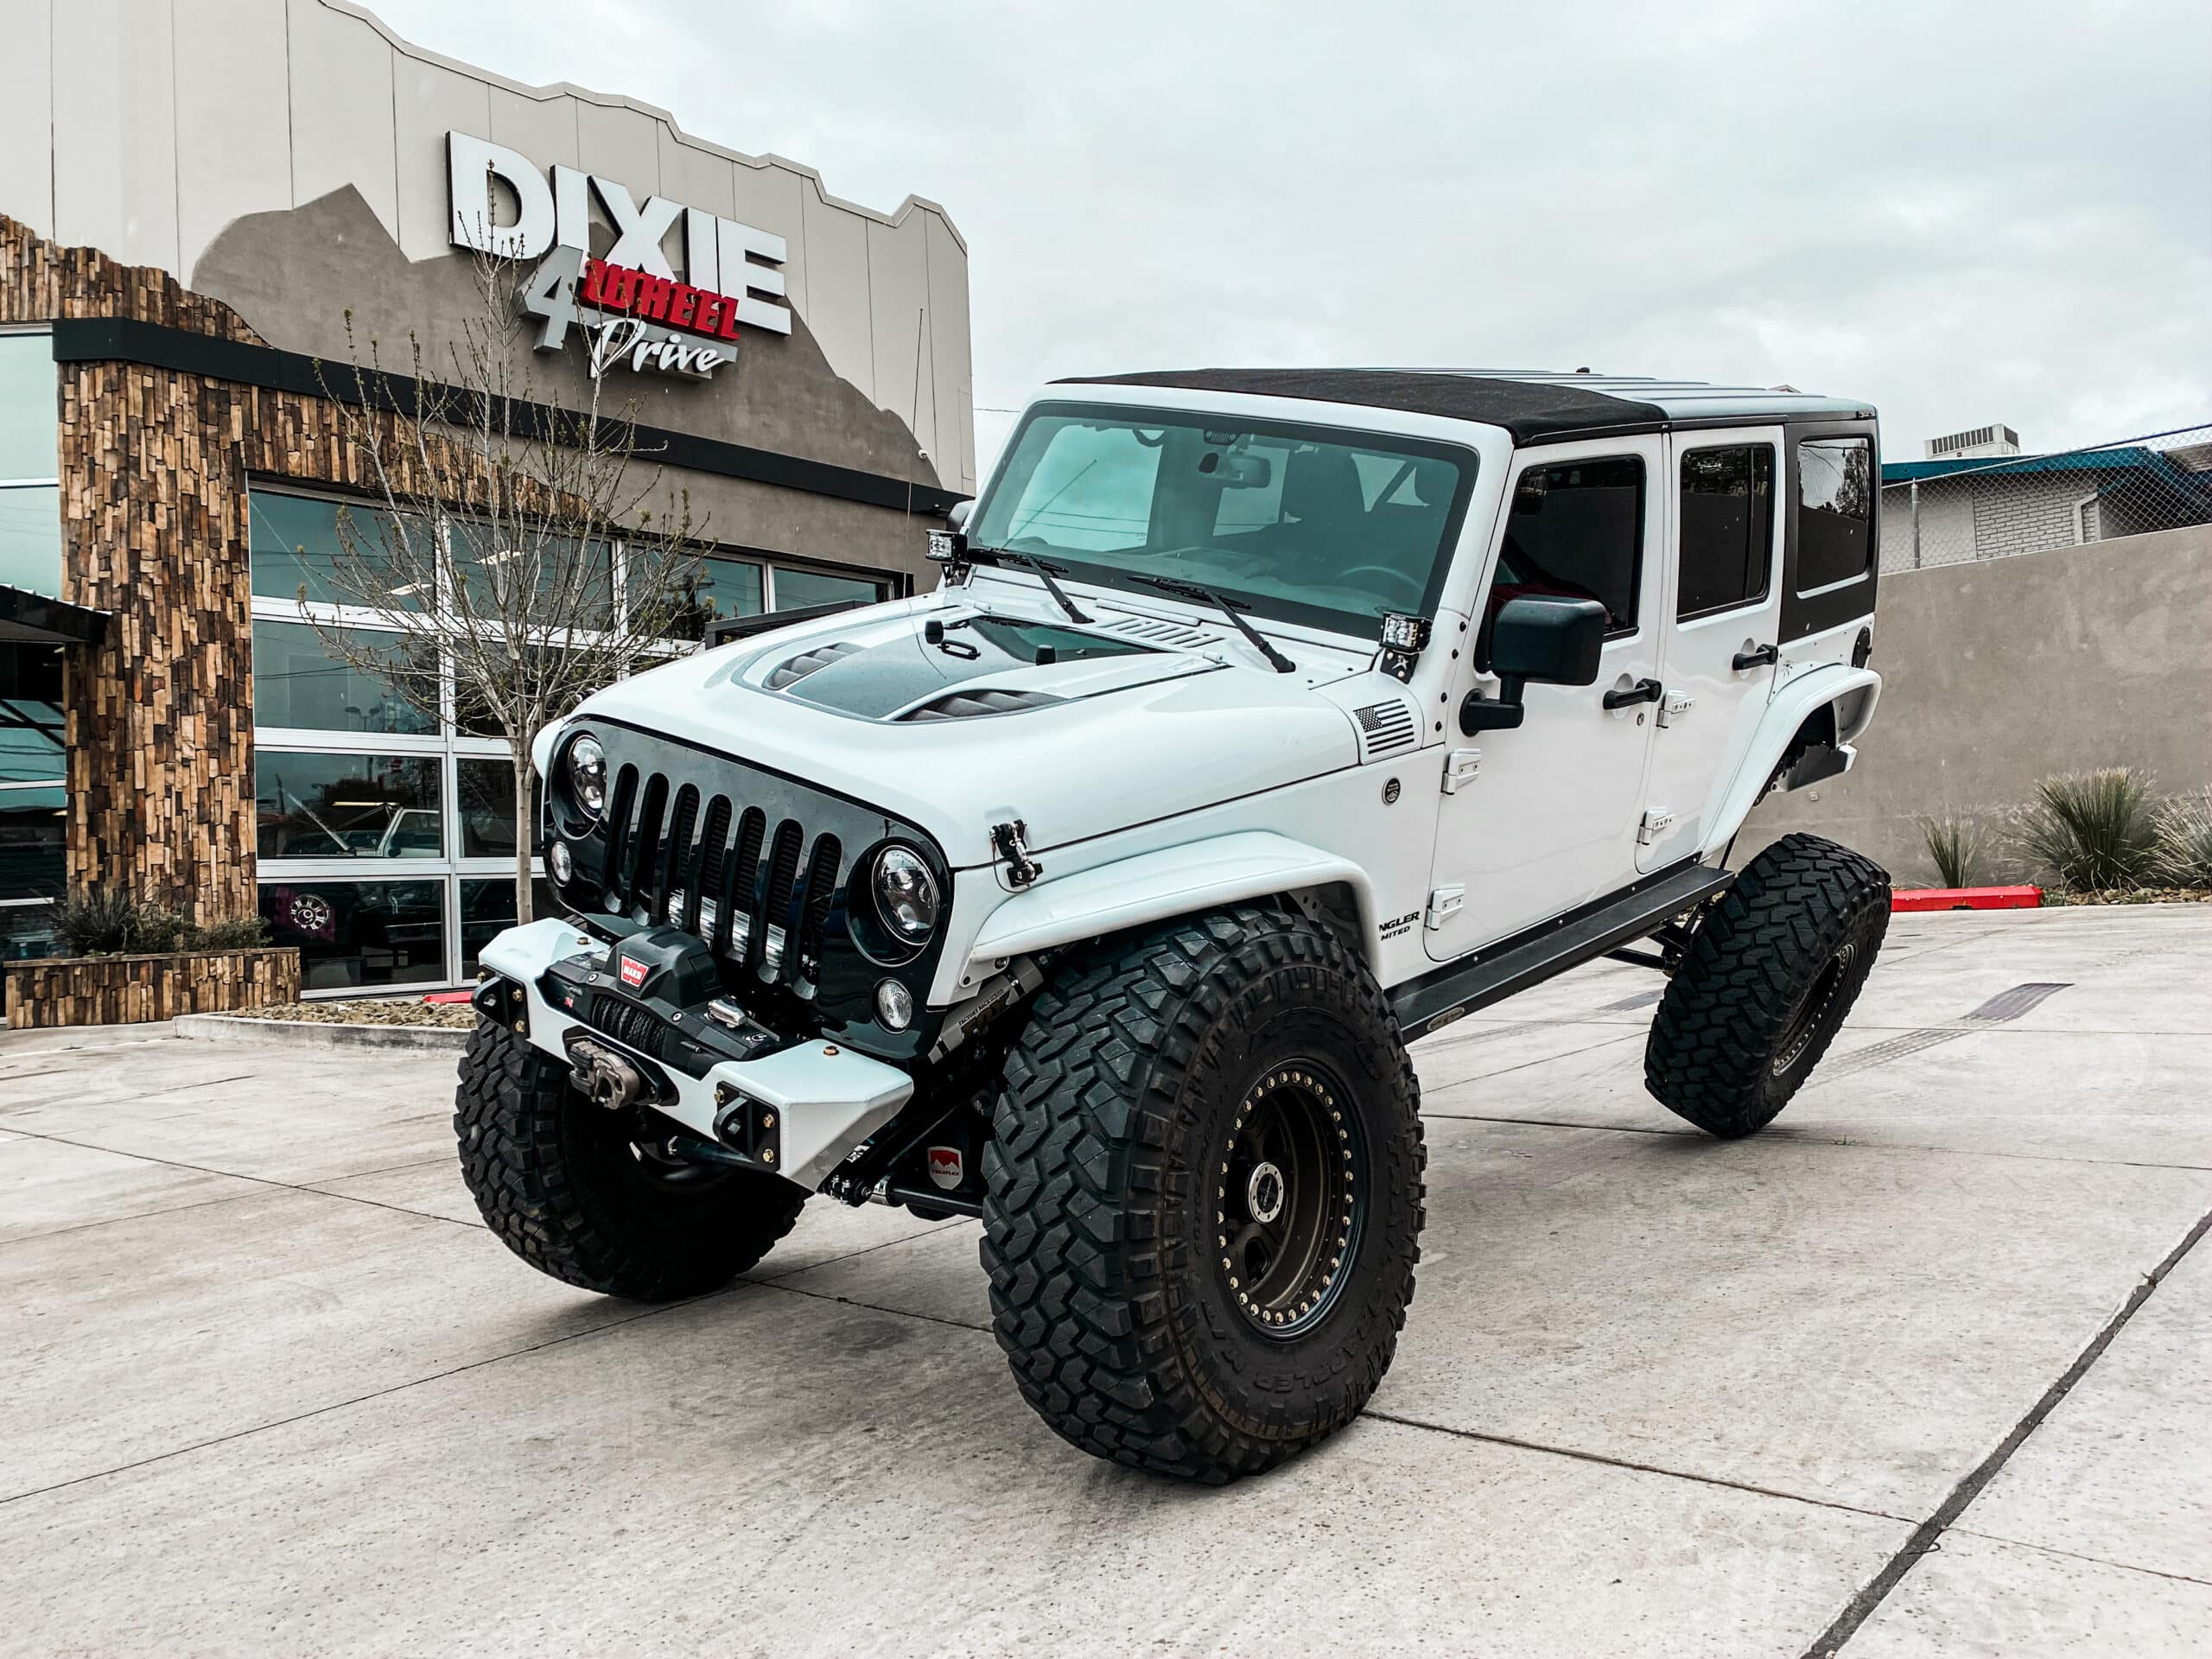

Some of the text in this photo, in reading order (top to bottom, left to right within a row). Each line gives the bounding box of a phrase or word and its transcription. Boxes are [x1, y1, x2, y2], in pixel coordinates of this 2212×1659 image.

[446, 130, 791, 335] DIXIE
[516, 245, 741, 353] 4 WHEEL
[588, 318, 725, 379] Drive
